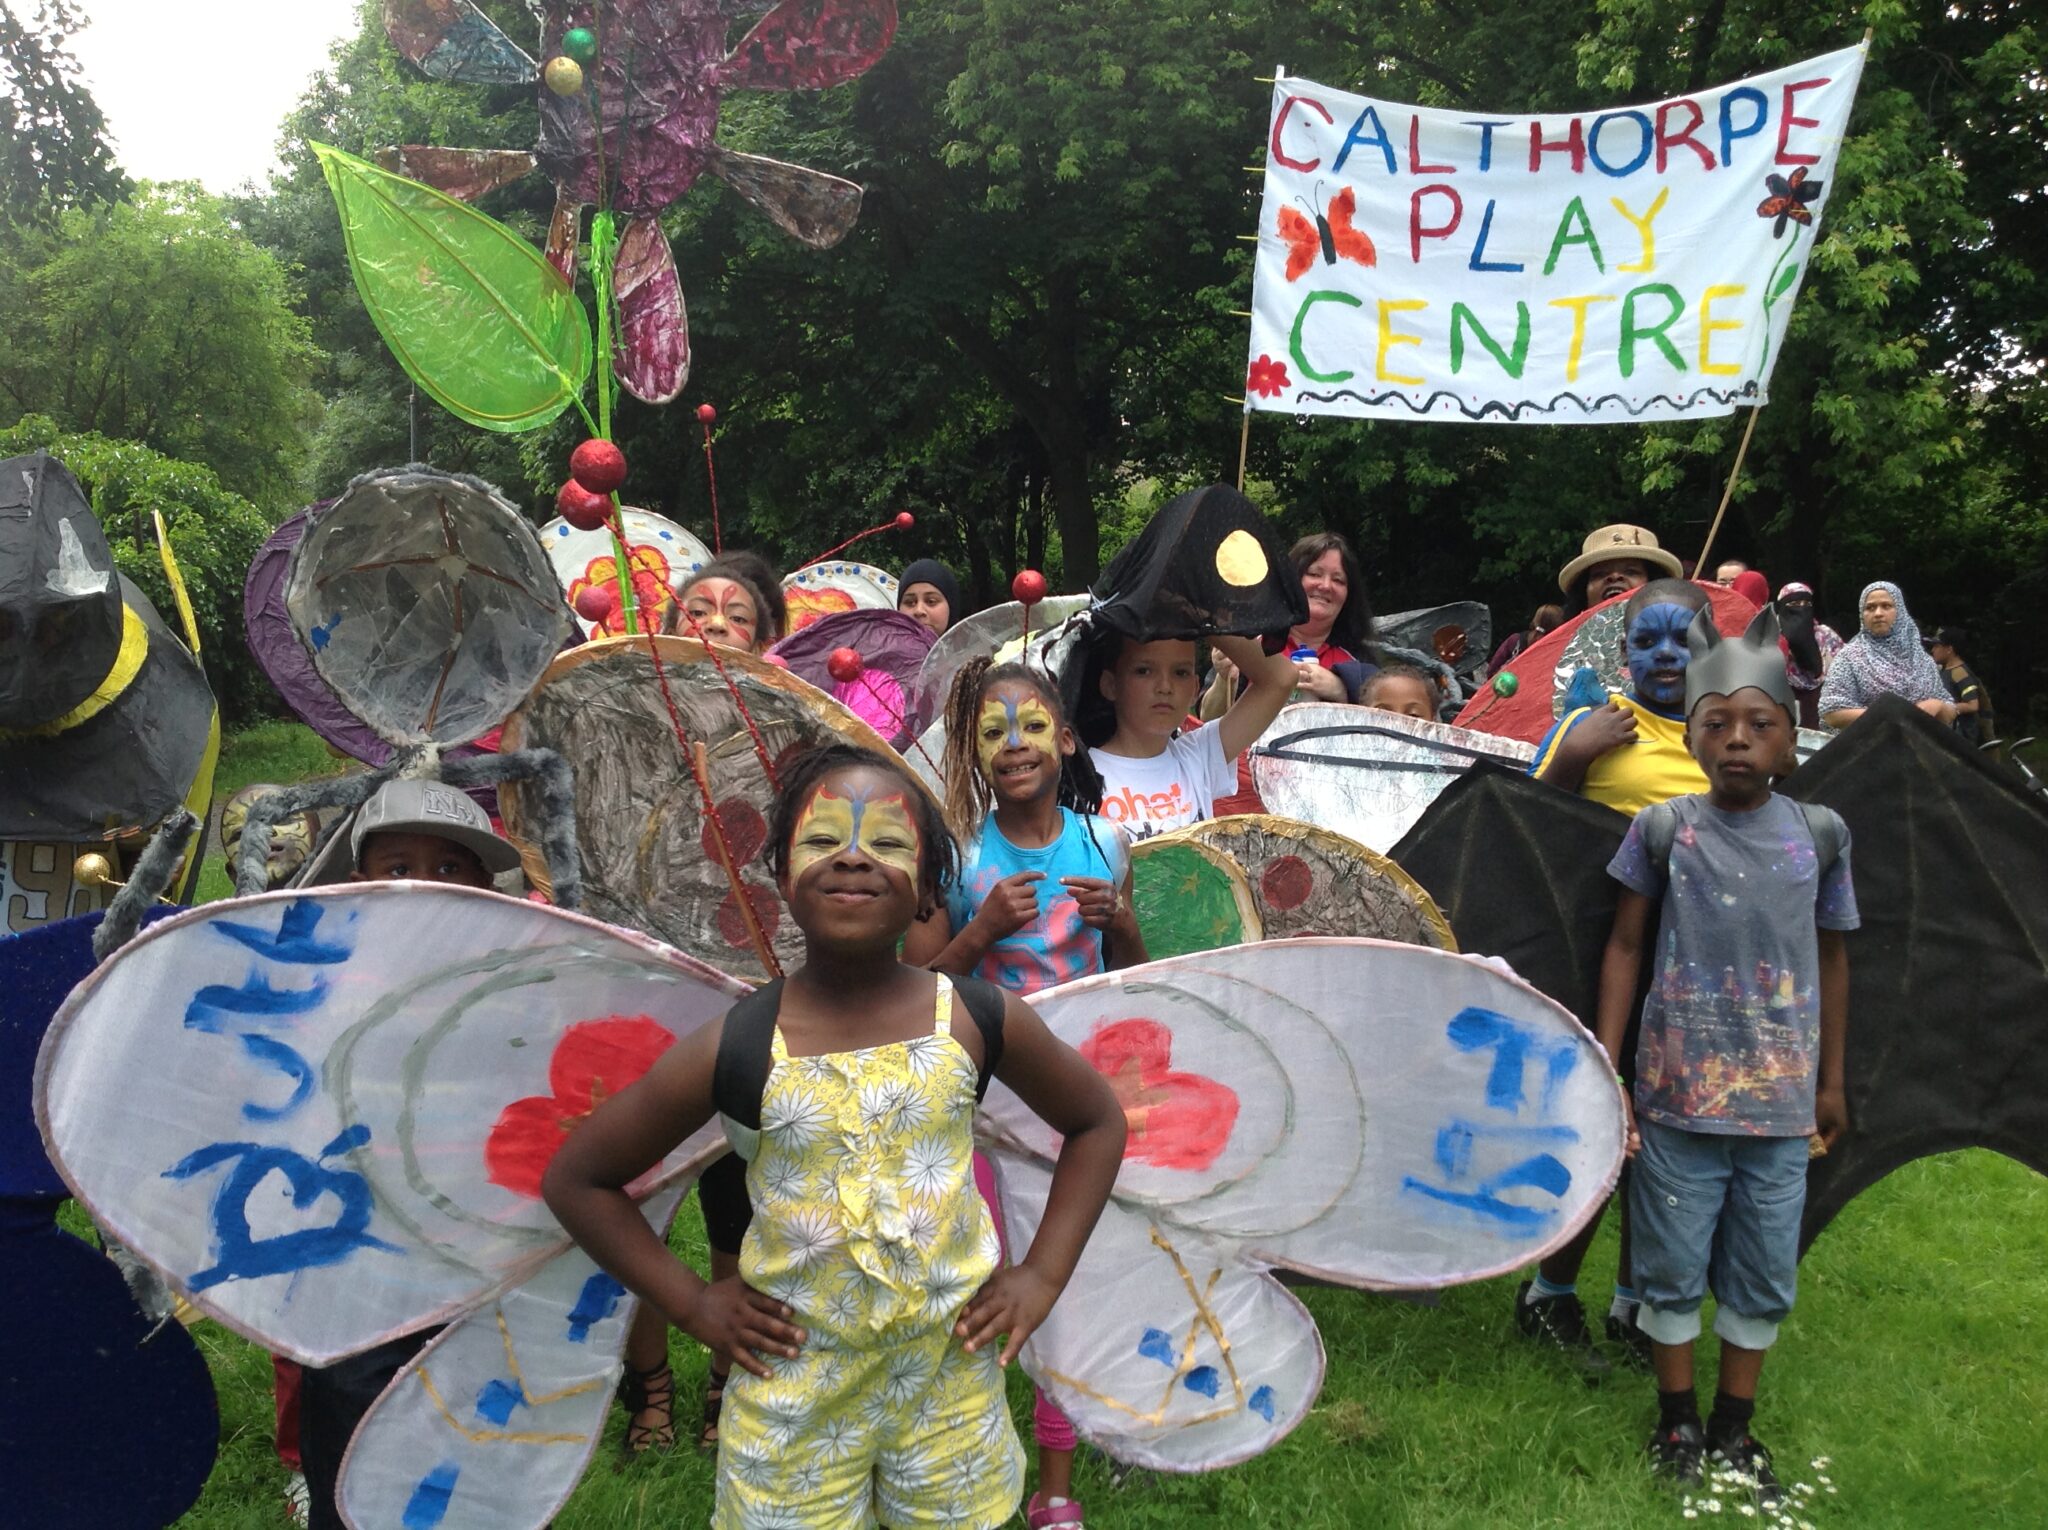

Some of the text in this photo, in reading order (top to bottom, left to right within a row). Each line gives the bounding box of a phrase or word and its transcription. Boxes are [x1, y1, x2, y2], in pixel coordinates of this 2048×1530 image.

[1271, 78, 1832, 177] CALTHORPE
[1411, 184, 1669, 276] PLAY
[1289, 282, 1747, 385] CENTRE
